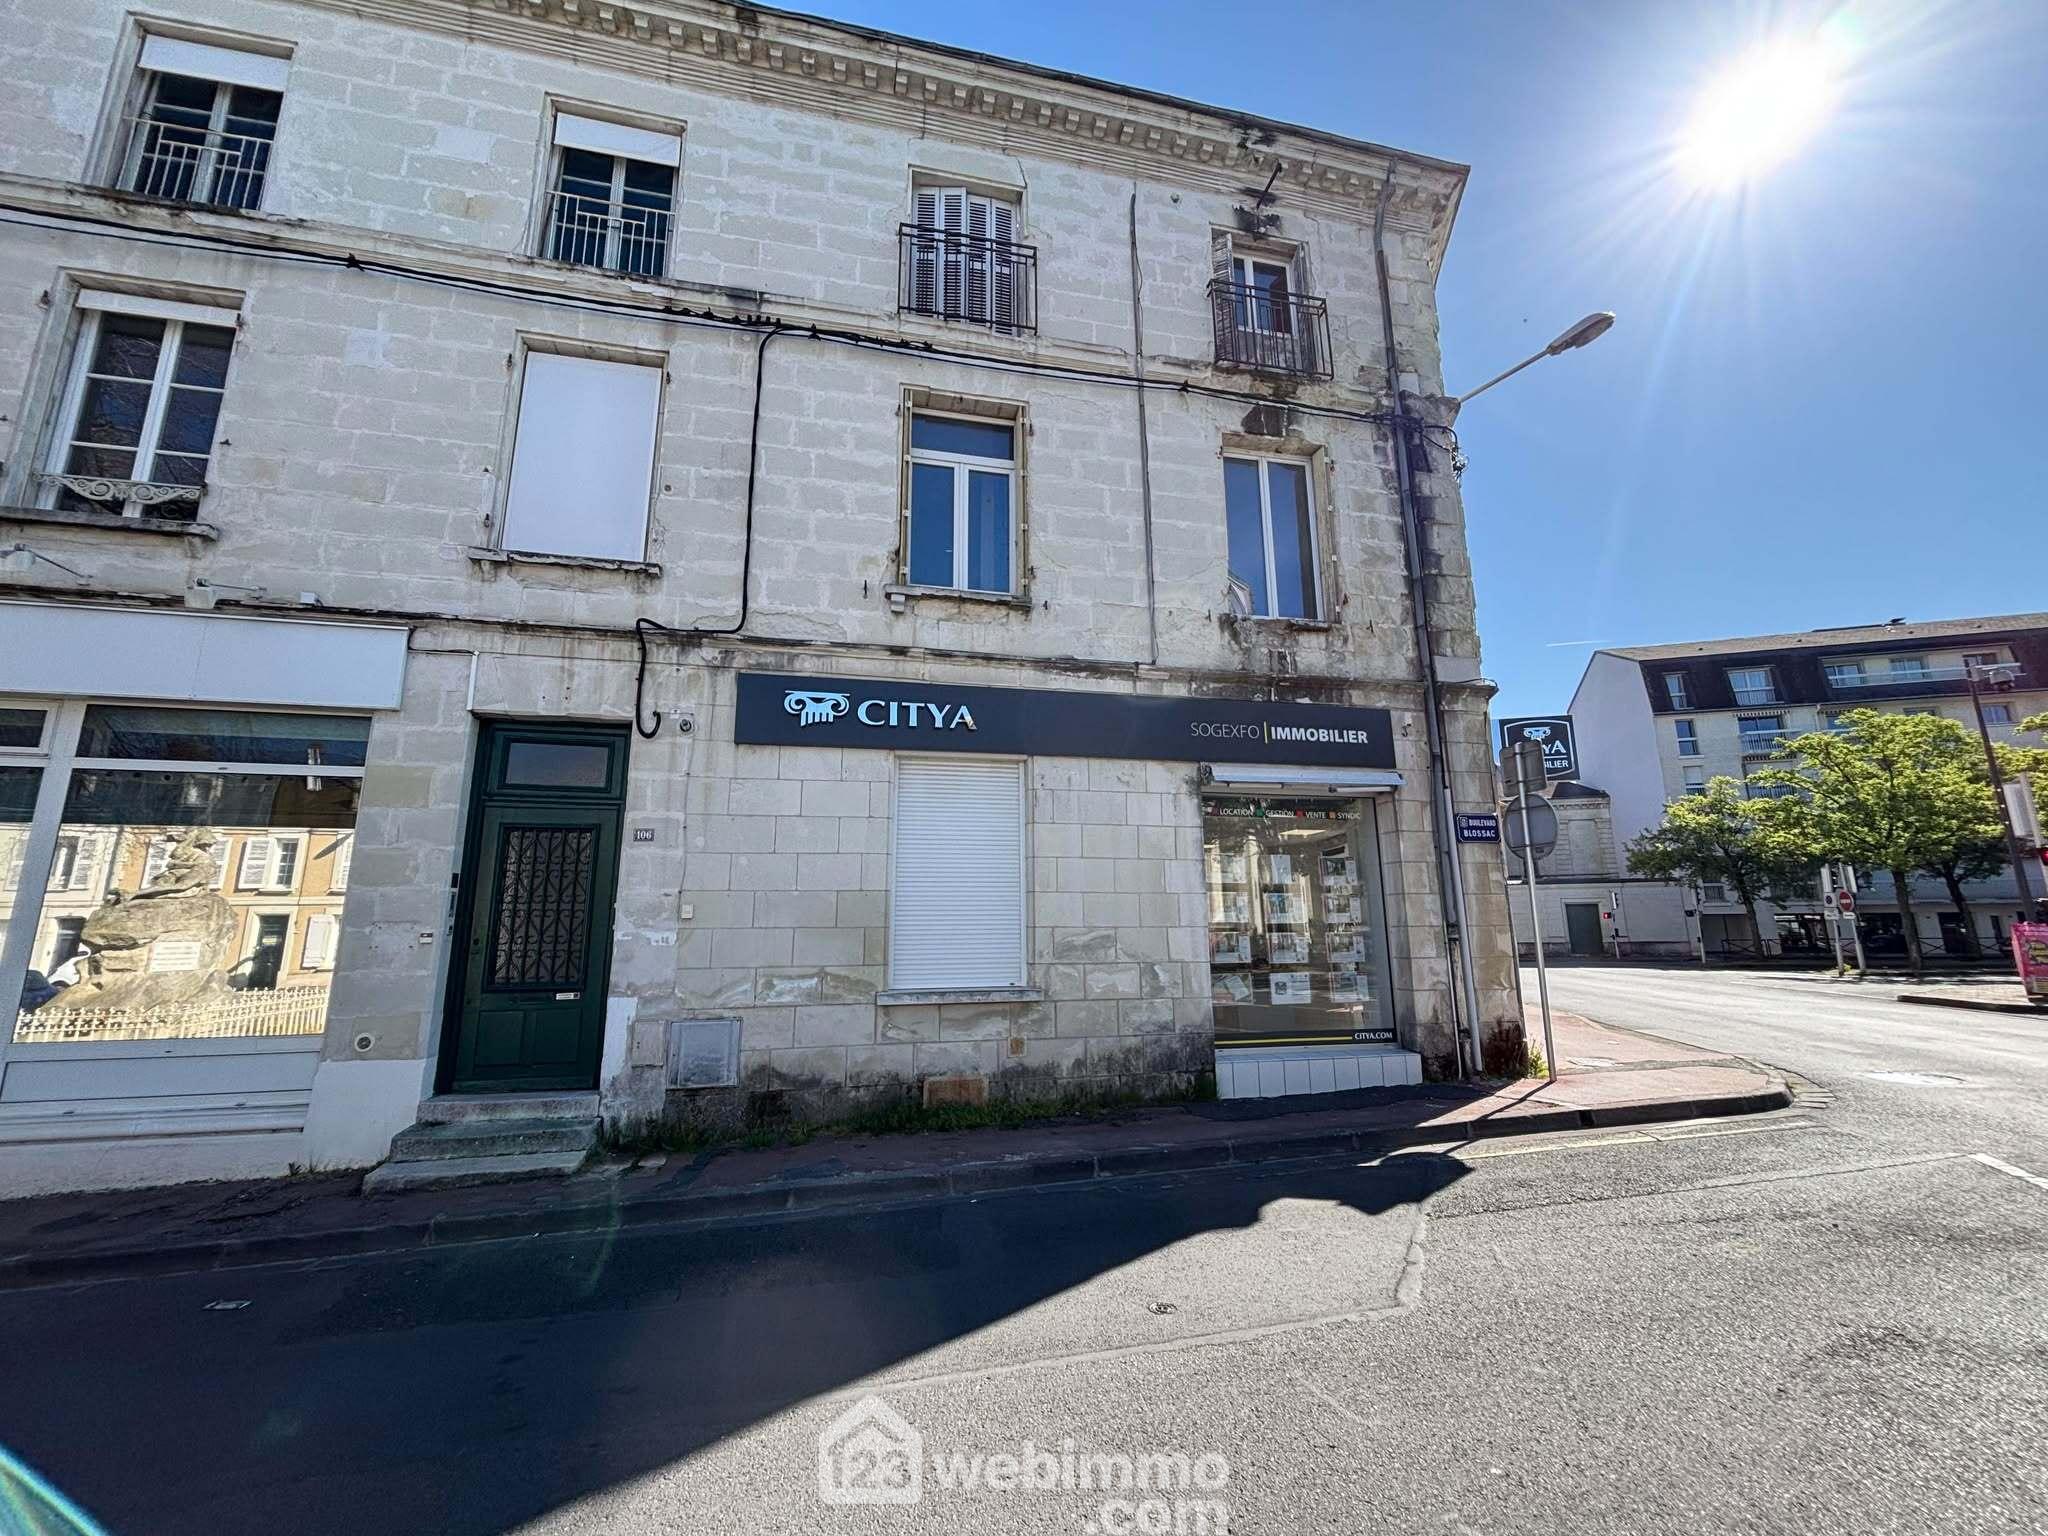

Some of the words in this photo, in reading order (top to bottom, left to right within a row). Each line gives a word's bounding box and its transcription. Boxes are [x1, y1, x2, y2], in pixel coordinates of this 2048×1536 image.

[857, 699, 977, 730] CITYA
[1190, 721, 1260, 739] SOGEXFO
[1271, 726, 1369, 744] IMMOBILIER
[1219, 808, 1253, 816] LOCATION
[1265, 809, 1295, 817] GESTION
[1305, 811, 1326, 819] VENTE
[636, 830, 652, 839] 106
[1463, 829, 1496, 837] BLOSSAC
[1354, 1031, 1393, 1040] CITYA.COM
